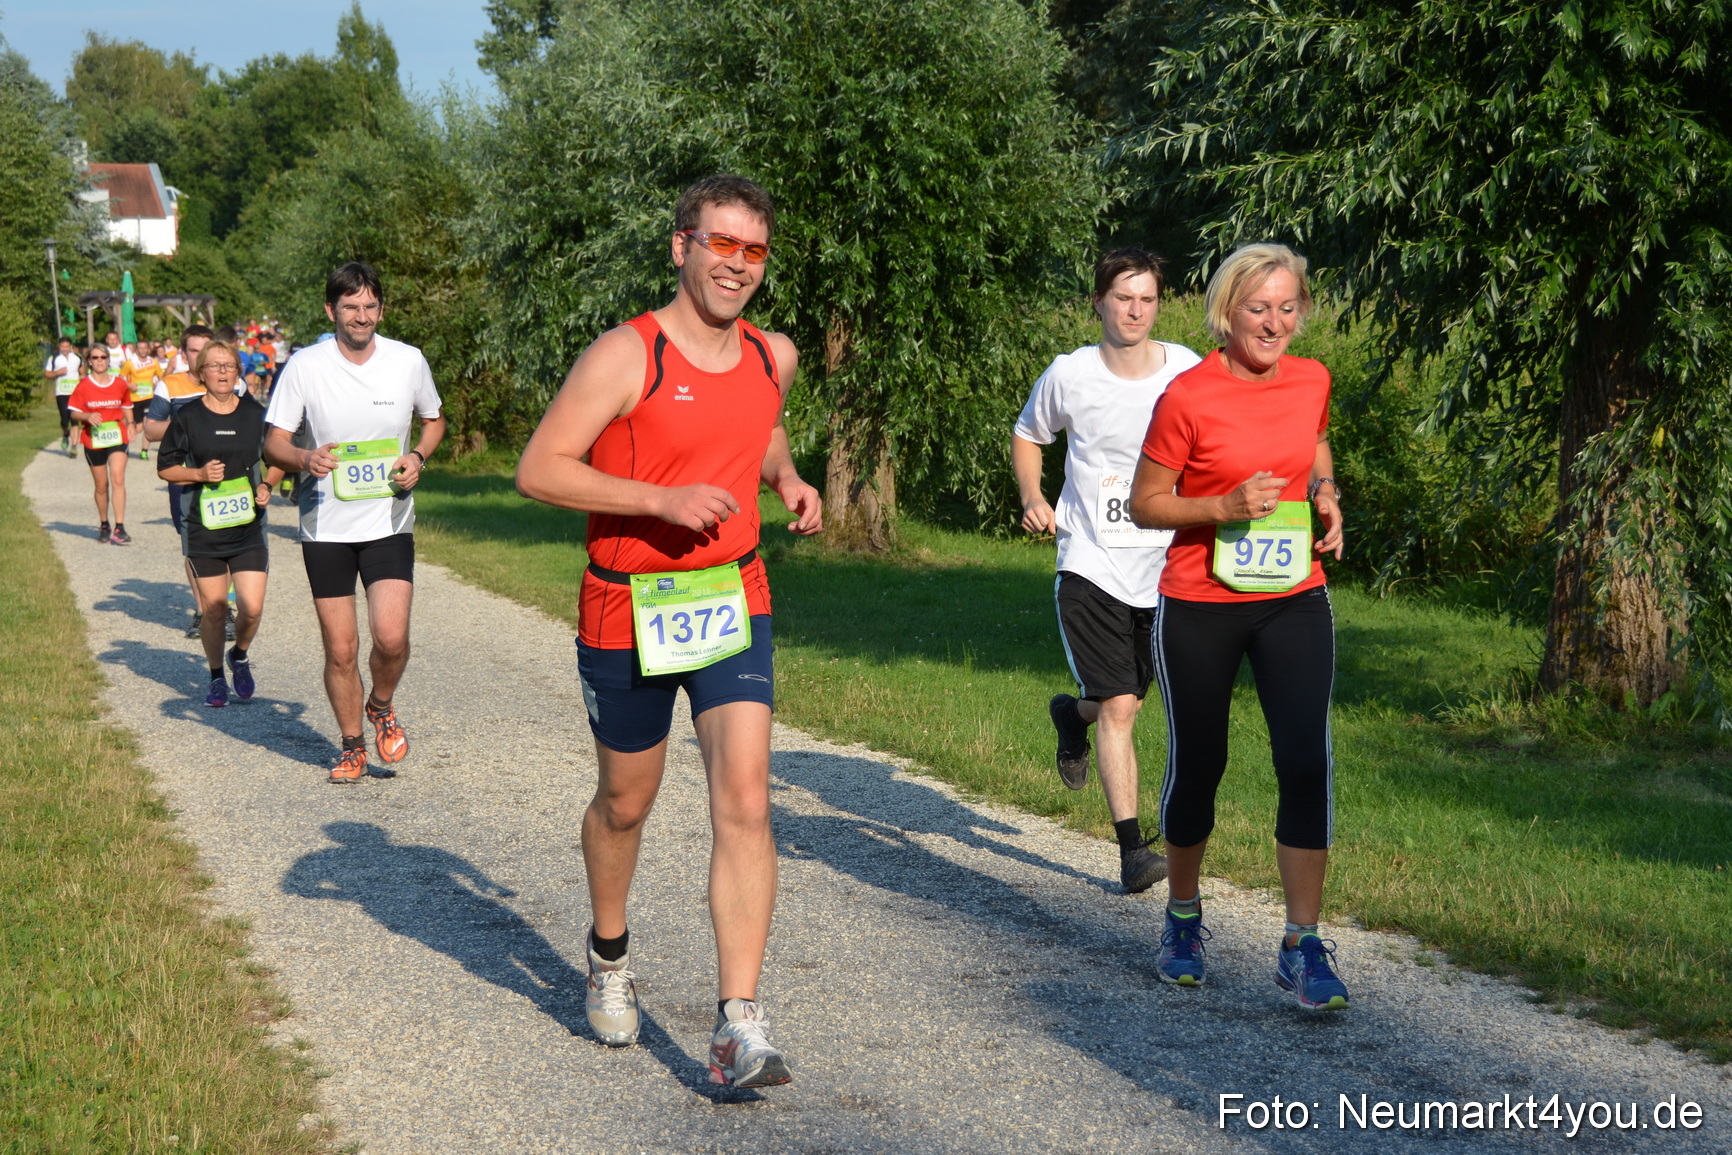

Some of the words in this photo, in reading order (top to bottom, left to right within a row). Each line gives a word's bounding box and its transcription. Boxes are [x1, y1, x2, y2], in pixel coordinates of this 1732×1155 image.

[347, 463, 386, 484] 981
[207, 496, 249, 516] 1238
[1235, 537, 1292, 567] 975
[650, 585, 691, 598] firmenlauf
[649, 604, 739, 645] 1372
[671, 648, 699, 658] Thomas
